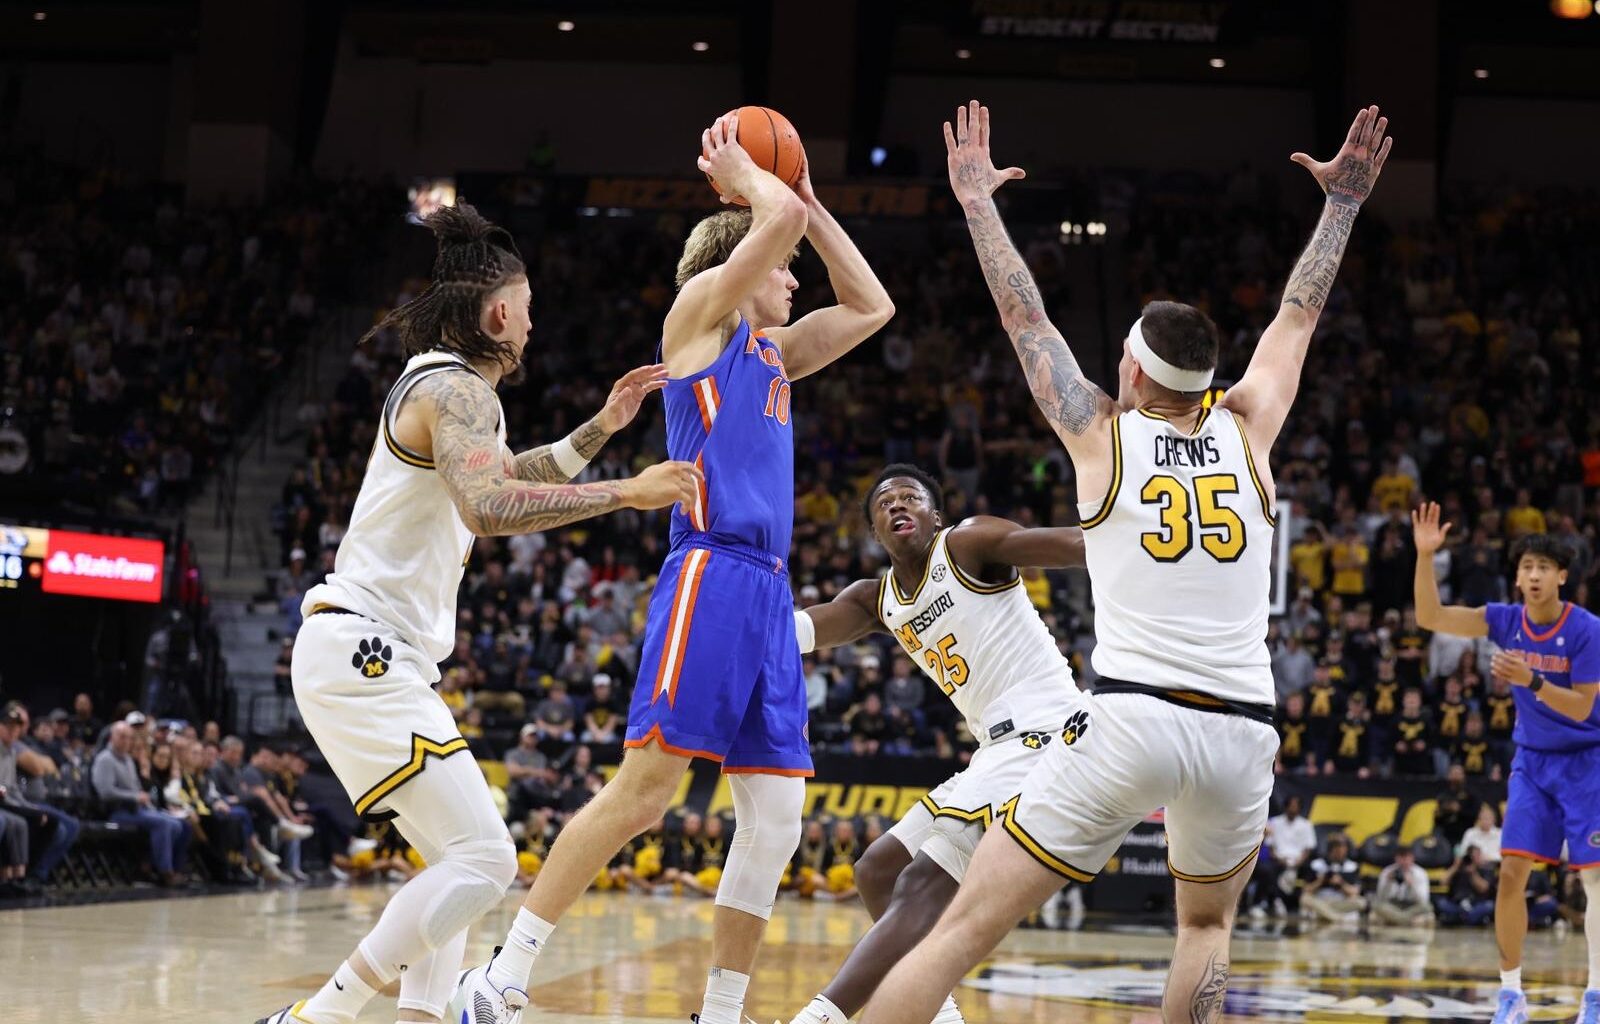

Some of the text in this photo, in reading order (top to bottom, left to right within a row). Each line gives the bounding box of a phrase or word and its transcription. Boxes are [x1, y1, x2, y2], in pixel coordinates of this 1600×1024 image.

[980, 16, 1219, 42] STUDENT SECTION
[764, 376, 791, 425] 10
[1154, 434, 1220, 467] CREWS
[1140, 473, 1247, 563] 35
[894, 591, 955, 654] MISSOURI
[365, 661, 385, 677] M
[924, 632, 970, 697] 25
